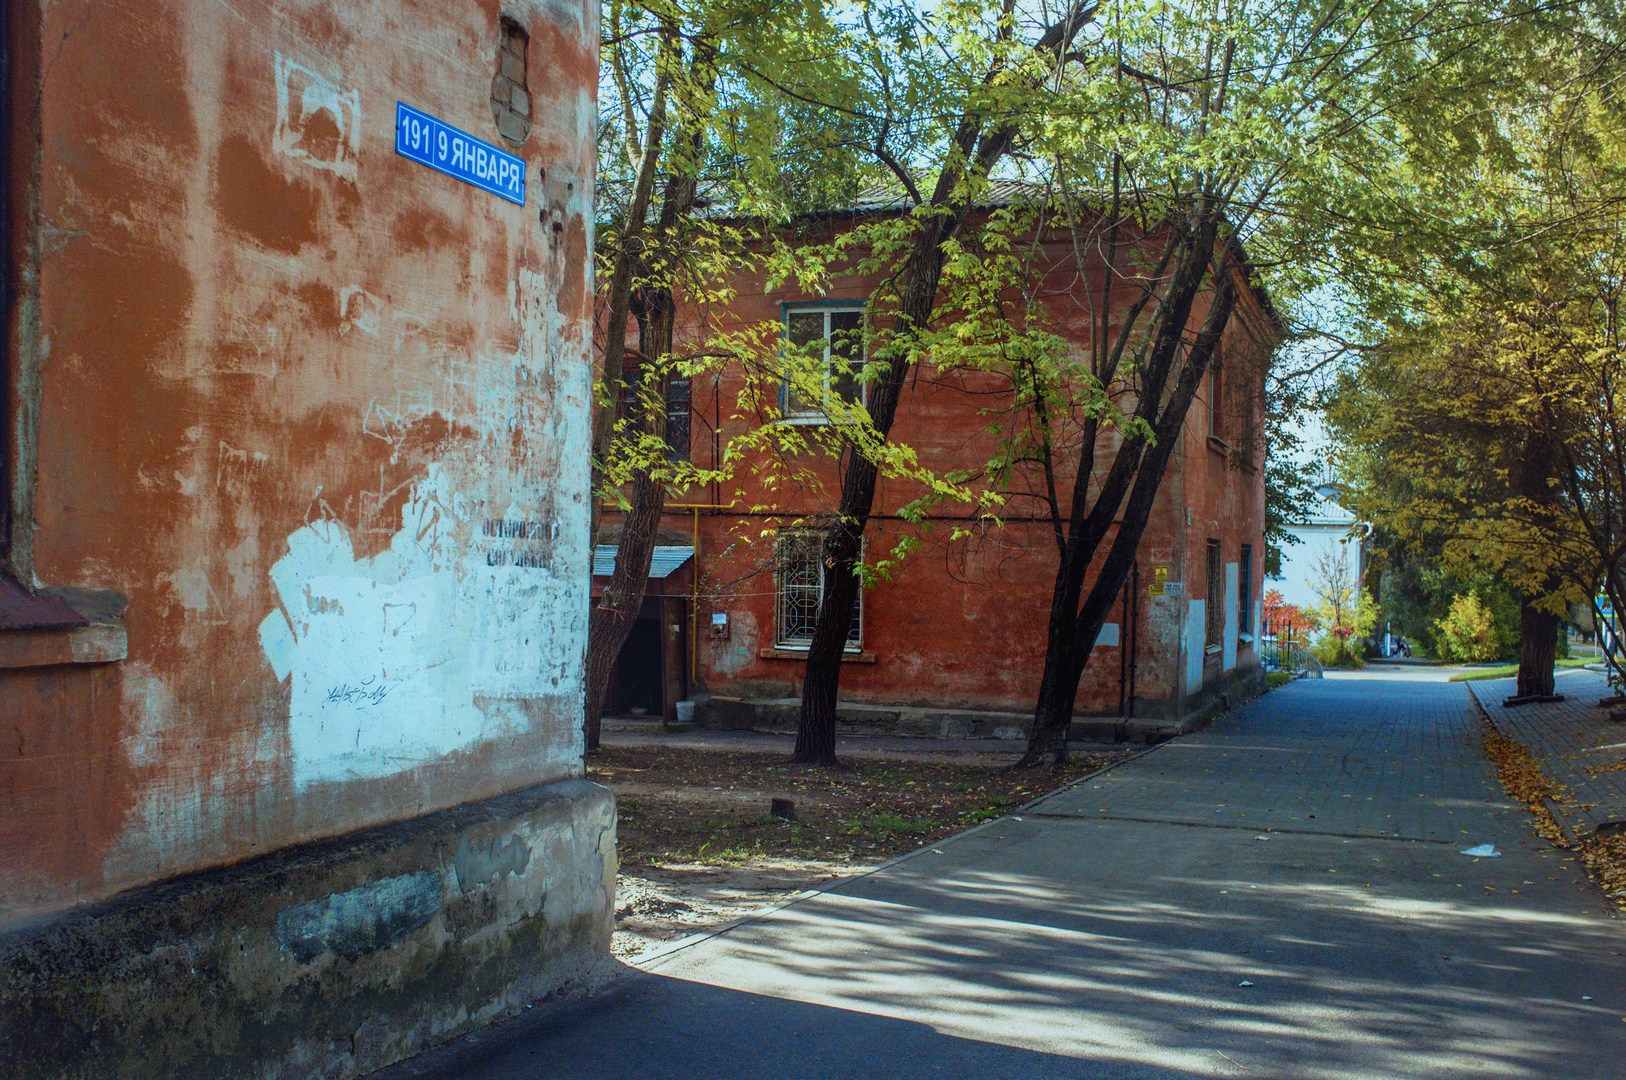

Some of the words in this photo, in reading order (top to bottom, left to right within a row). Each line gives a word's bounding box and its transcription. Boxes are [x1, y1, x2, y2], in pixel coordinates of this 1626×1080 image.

[402, 115, 430, 154] 191
[438, 130, 448, 161] 9
[451, 137, 520, 193] ЯНВАРЯ
